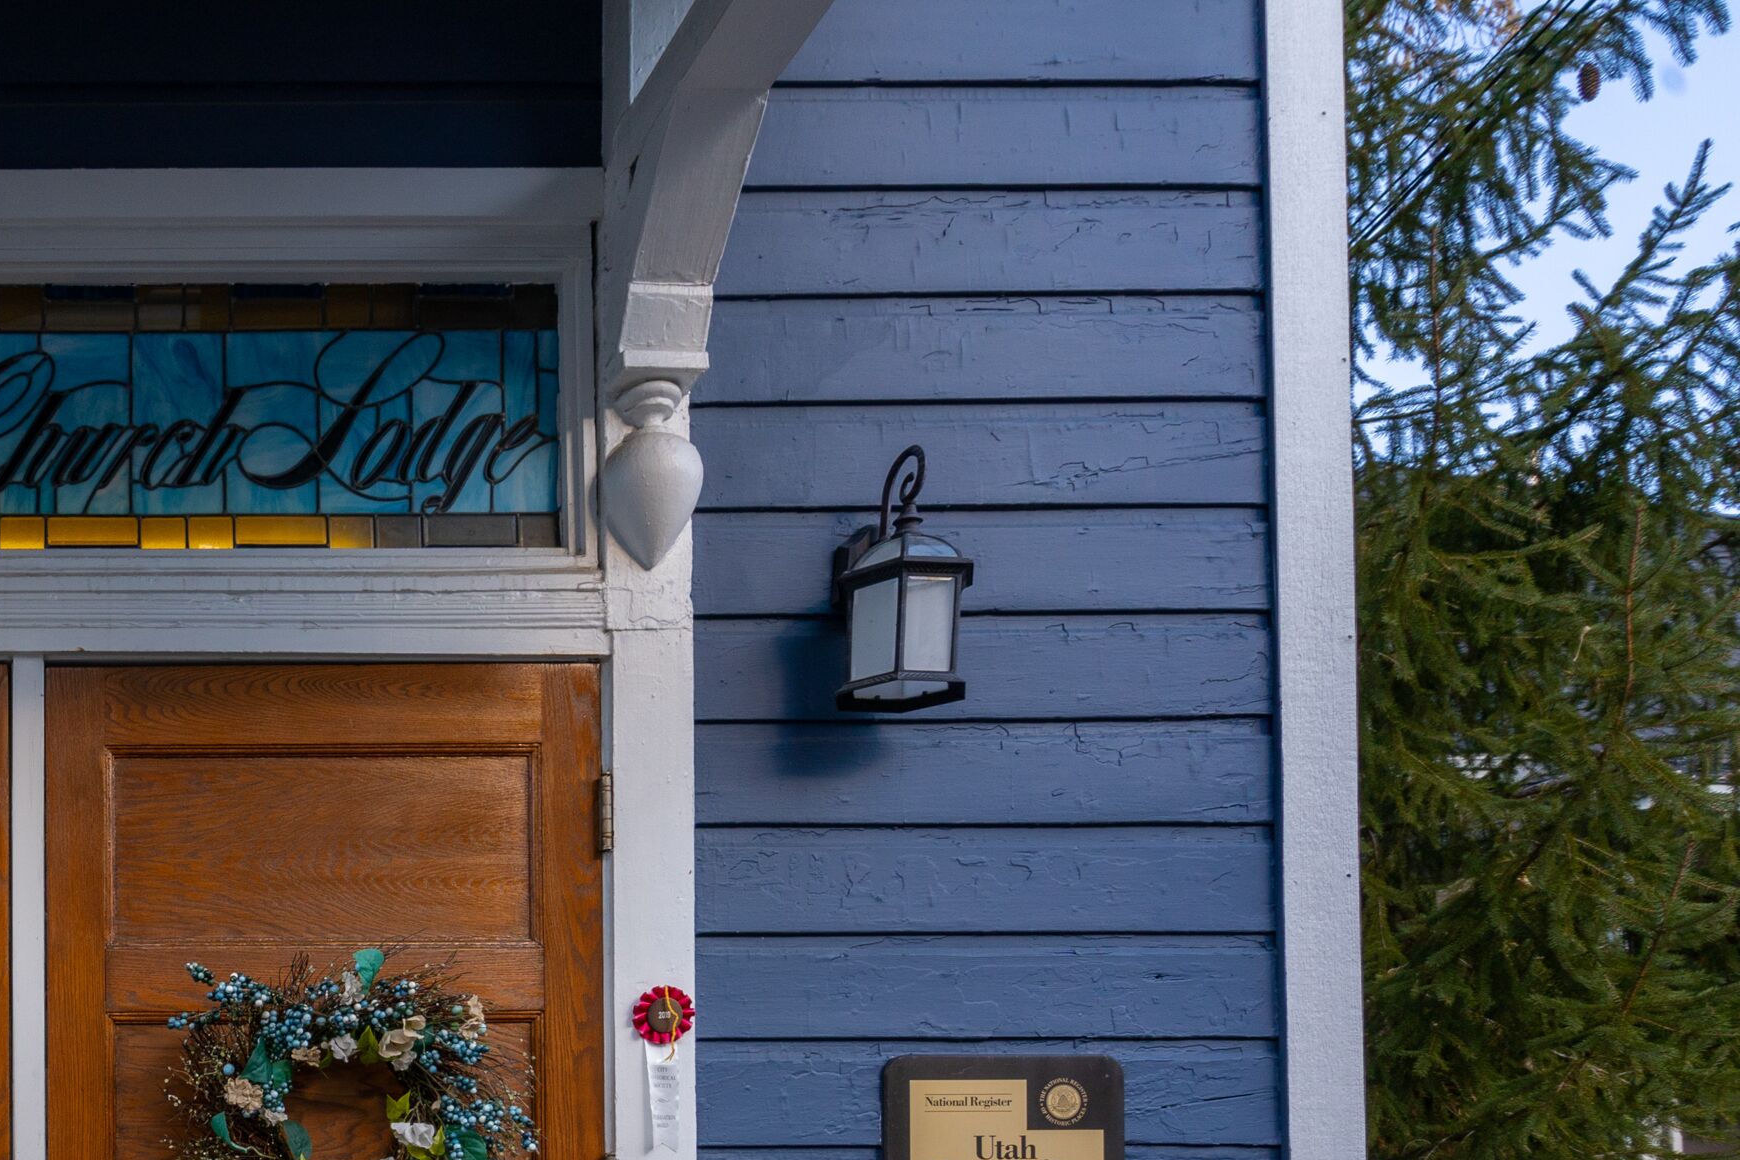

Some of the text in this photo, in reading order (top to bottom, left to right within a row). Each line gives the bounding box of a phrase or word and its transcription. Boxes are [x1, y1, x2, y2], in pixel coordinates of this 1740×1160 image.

[237, 331, 544, 513] Lodge
[925, 1096, 1012, 1108] National Register
[1044, 1077, 1069, 1089] NATIONAL
[1070, 1079, 1088, 1102] REGISTER
[1046, 1114, 1071, 1126] HISTORIC
[1071, 1108, 1086, 1124] PLACES
[973, 1135, 1038, 1160] Utah
